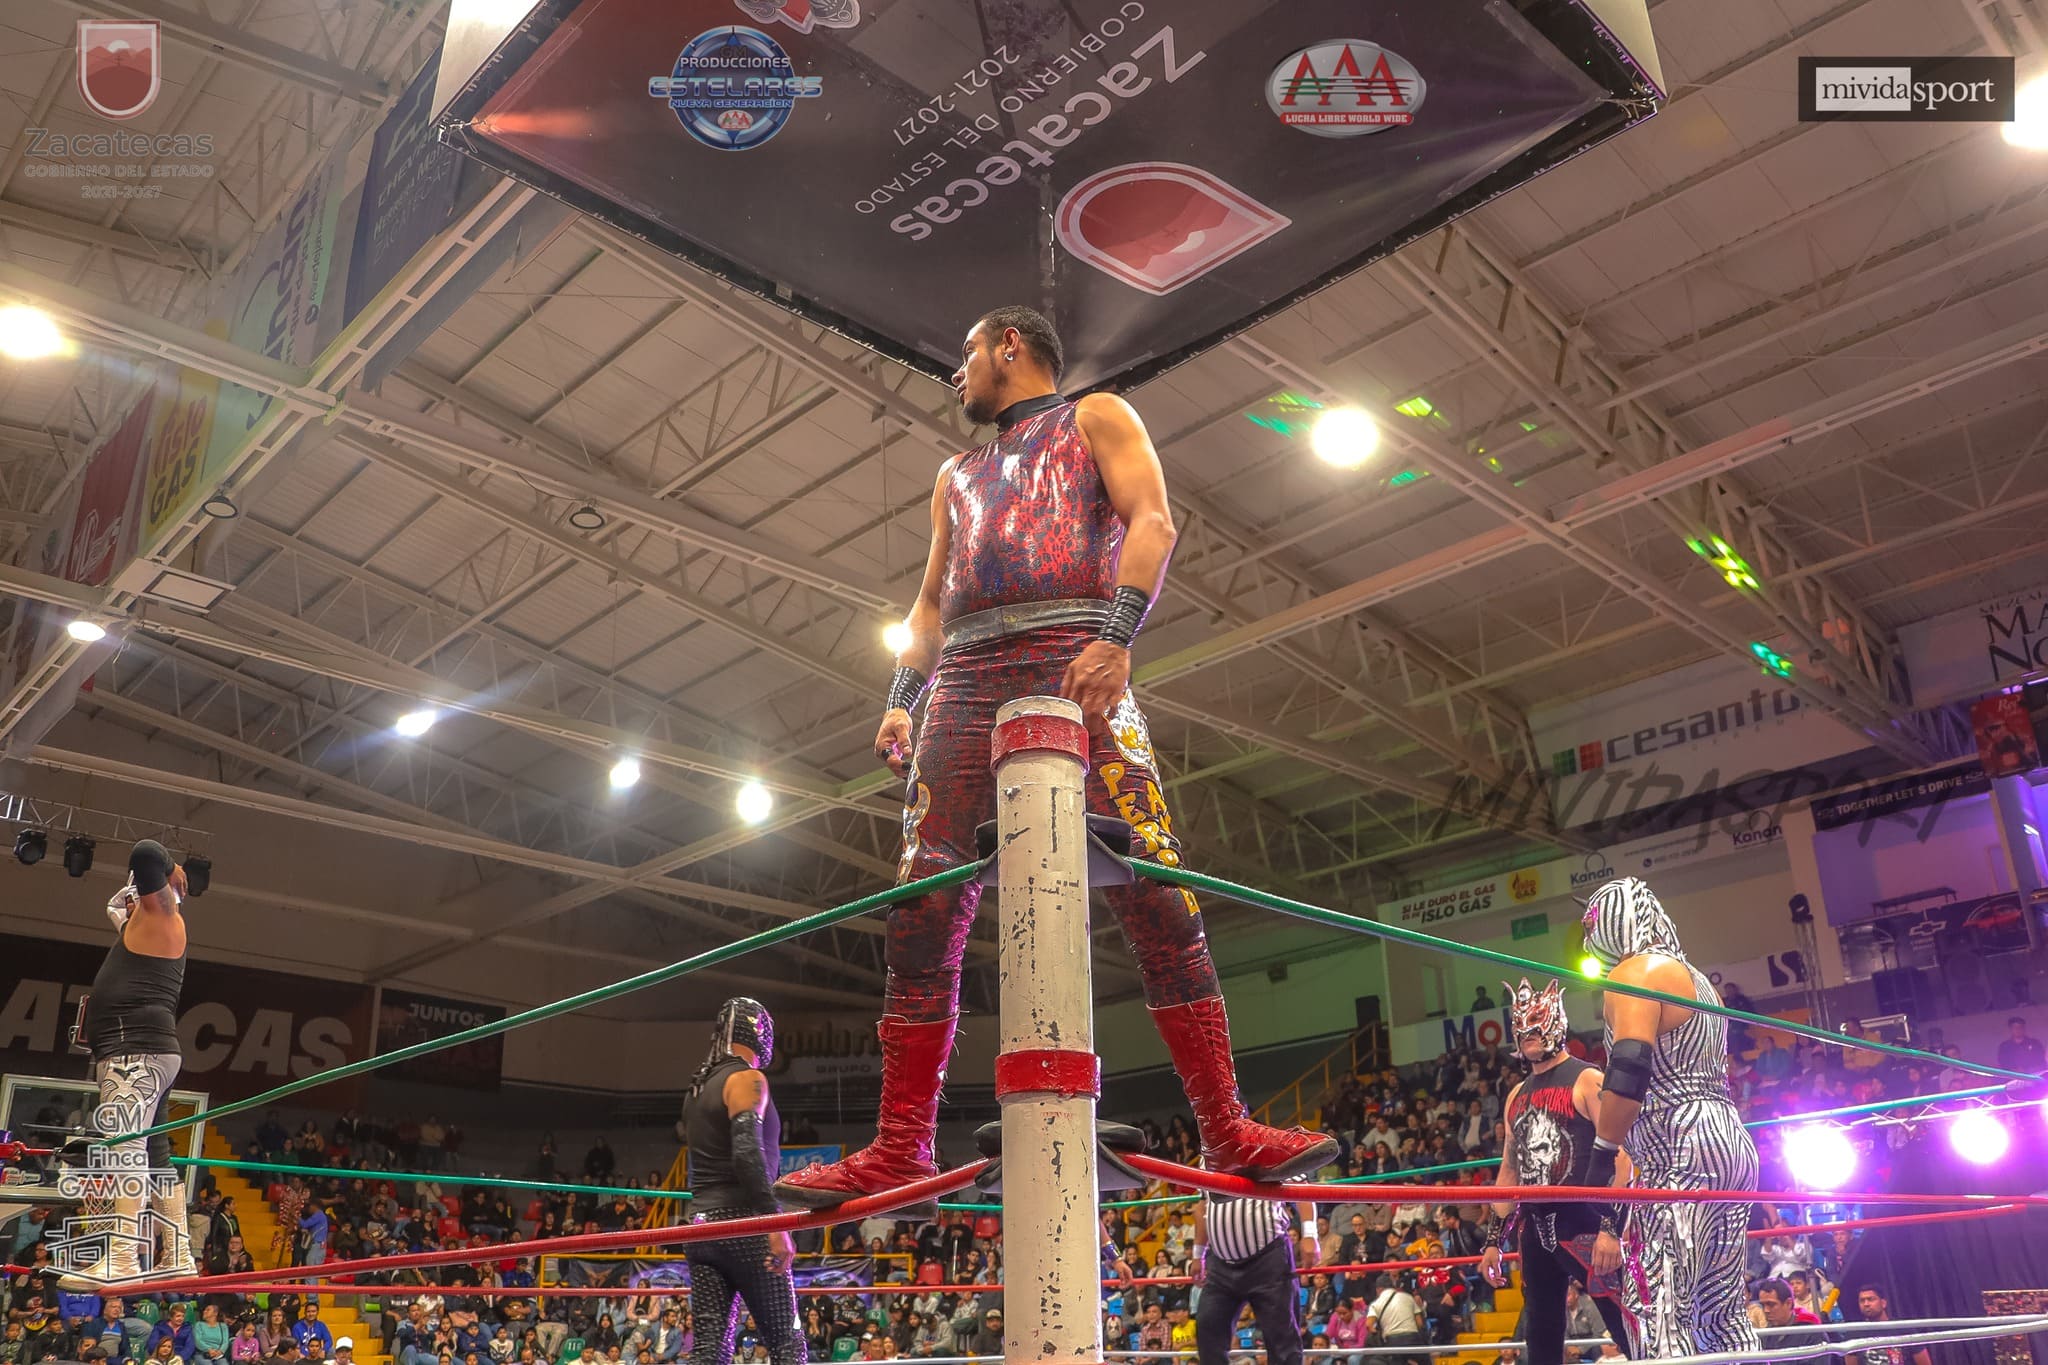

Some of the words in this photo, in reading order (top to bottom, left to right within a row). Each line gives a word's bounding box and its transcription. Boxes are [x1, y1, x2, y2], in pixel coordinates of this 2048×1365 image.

[680, 57, 791, 68] PRODUCCIONES
[1000, 1, 1145, 113] GOBIERNO
[649, 76, 823, 97] ESTELARES
[1280, 43, 1409, 106] AAA
[670, 99, 711, 109] NUEVA
[893, 44, 1021, 146] 2021-2027
[943, 112, 1000, 150] DEL
[1285, 113, 1316, 123] LUCHA
[1318, 113, 1346, 123] LIBRE
[1348, 113, 1381, 123] WORLD
[1383, 113, 1408, 123] WIDE
[890, 25, 1207, 241] Zacatecas
[855, 151, 948, 214] ESTADO
[1836, 793, 1893, 816] TOGETHER
[1928, 776, 1963, 793] DRIVE
[1732, 825, 1783, 845] Kanan
[1570, 867, 1615, 885] Kanan
[1474, 883, 1496, 896] GAS
[1421, 905, 1455, 923] ISLO
[1459, 895, 1492, 914] GAS
[408, 1003, 486, 1027] JUNTOS
